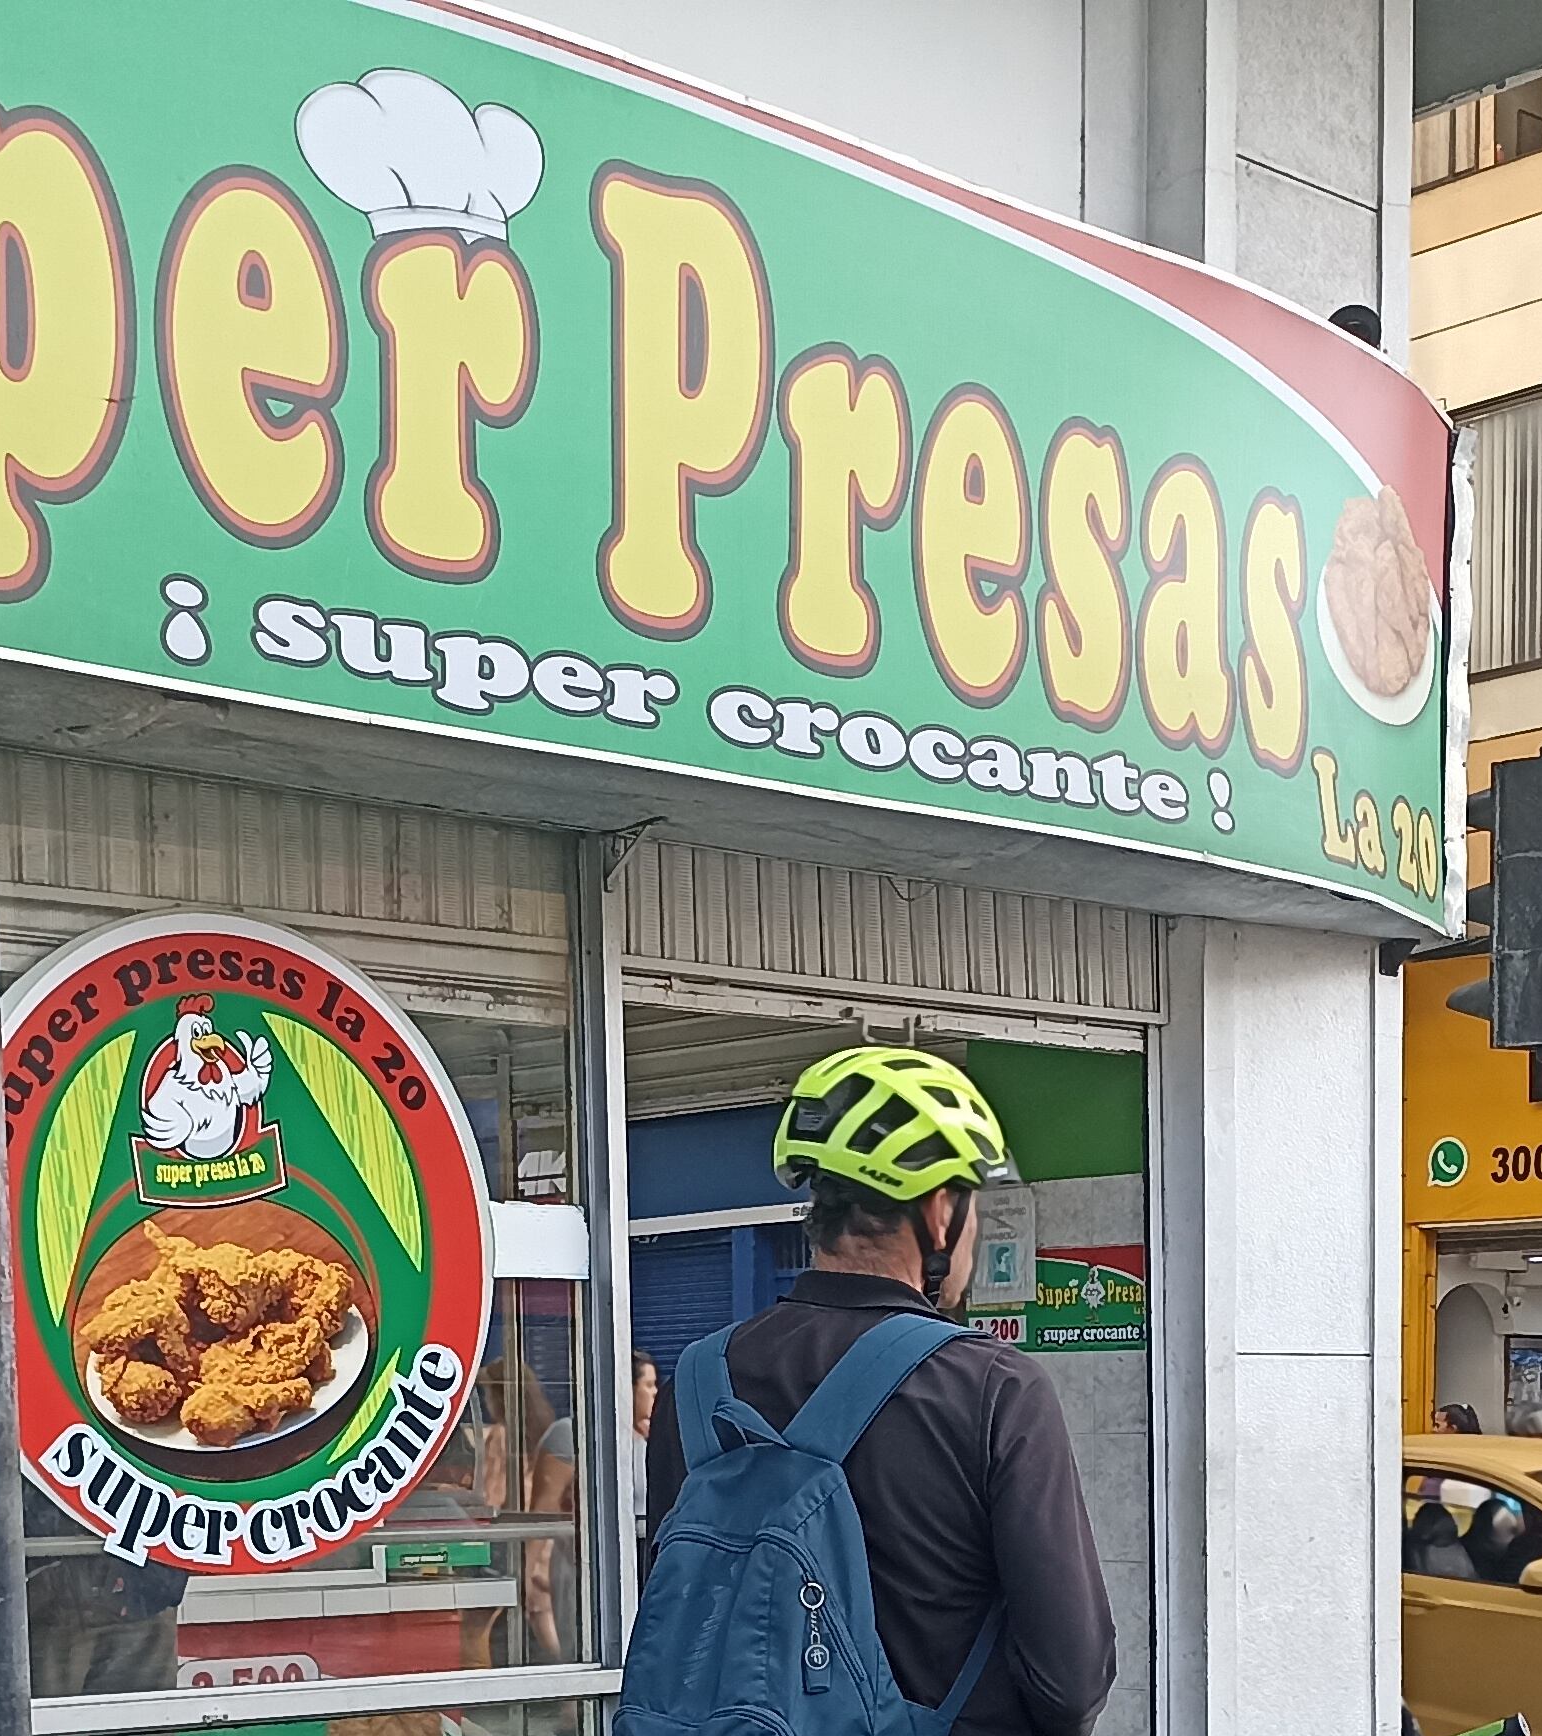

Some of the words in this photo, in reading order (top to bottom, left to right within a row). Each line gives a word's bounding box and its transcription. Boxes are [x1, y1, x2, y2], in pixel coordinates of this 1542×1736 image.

[590, 158, 1309, 778] Presas
[251, 590, 680, 728] super
[709, 684, 1191, 826] crocante
[1313, 747, 1385, 878] La
[1395, 800, 1441, 902] 20
[114, 944, 307, 1008] presas
[318, 984, 367, 1044] la
[371, 1037, 428, 1112] 20
[155, 1163, 193, 1189] super
[235, 1153, 251, 1177] la
[1036, 1282, 1079, 1310] Super
[1043, 1327, 1082, 1344] super
[1083, 1323, 1140, 1341] crocante
[43, 1424, 240, 1564] super
[248, 1346, 460, 1560] crocante
